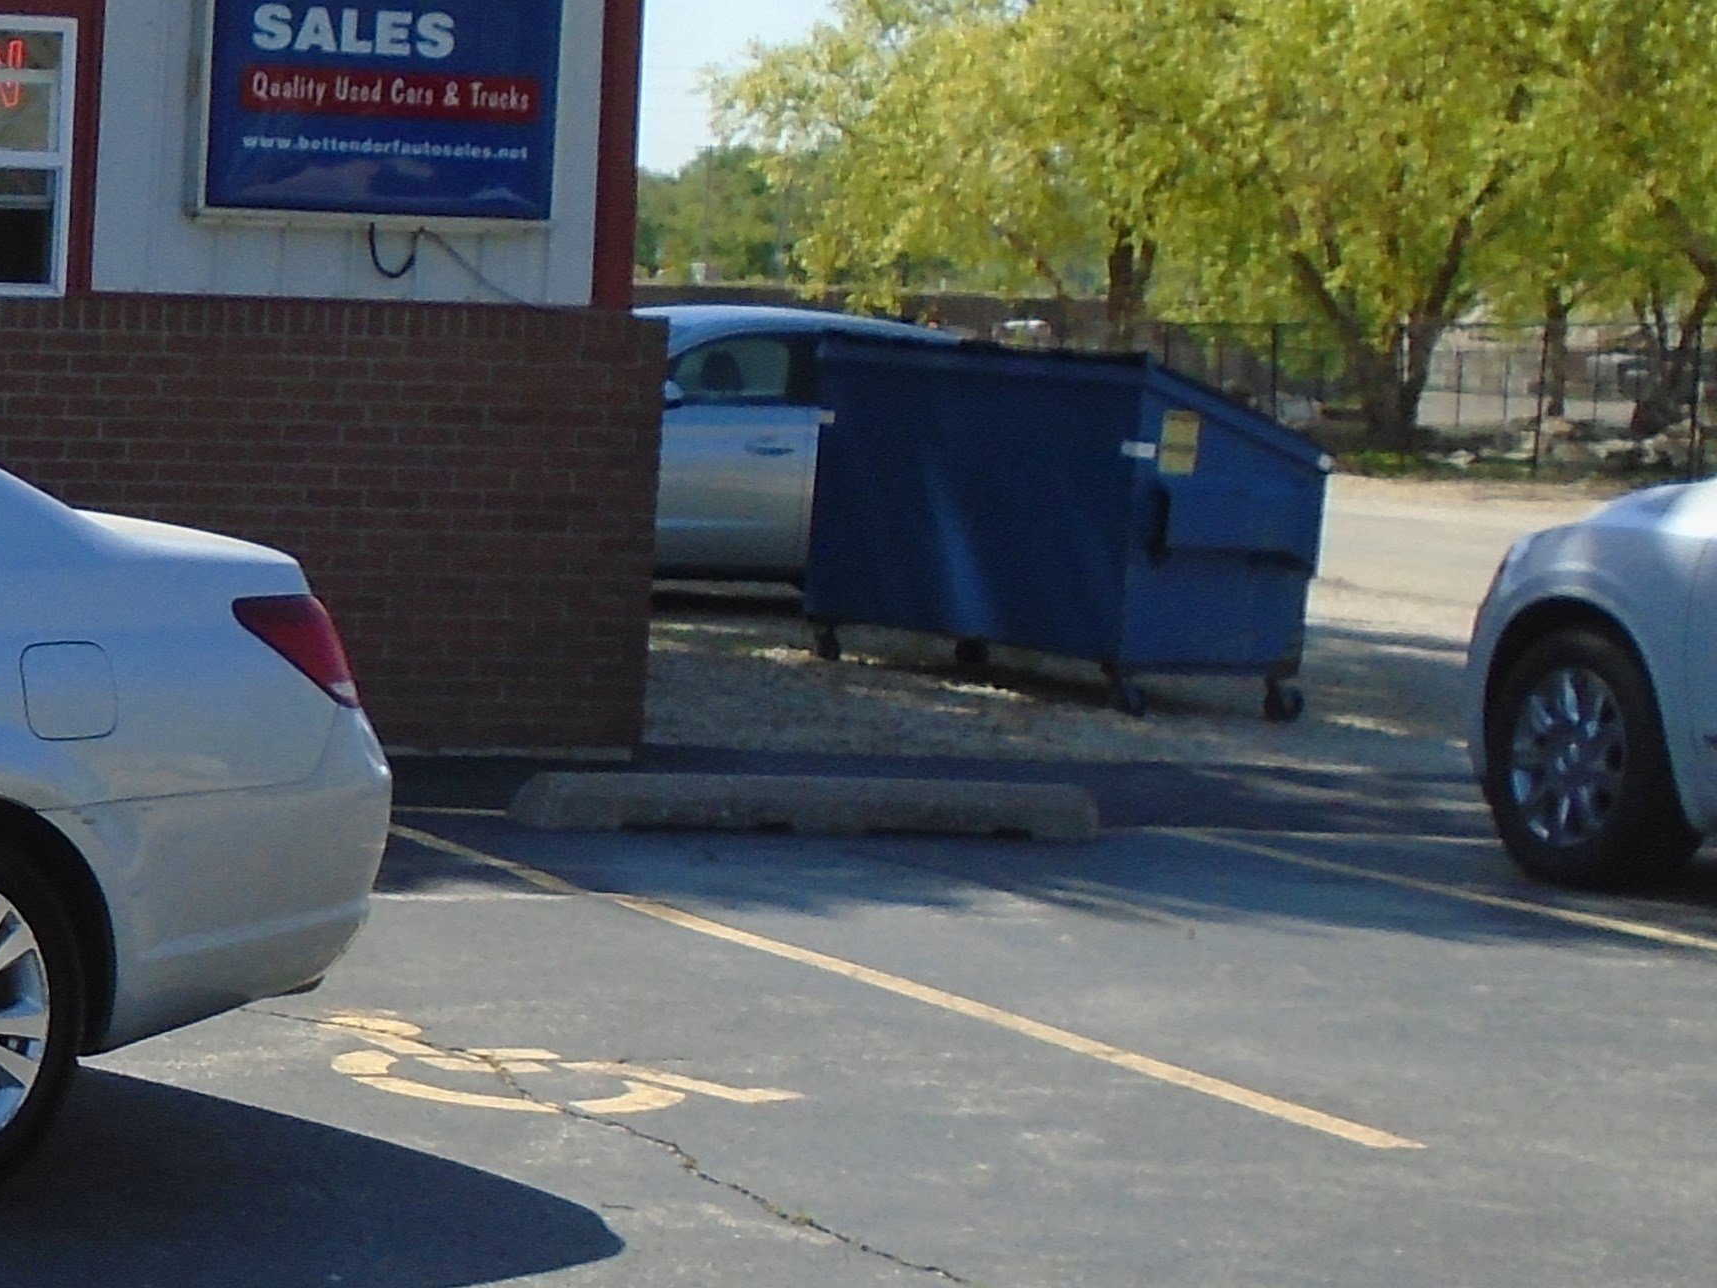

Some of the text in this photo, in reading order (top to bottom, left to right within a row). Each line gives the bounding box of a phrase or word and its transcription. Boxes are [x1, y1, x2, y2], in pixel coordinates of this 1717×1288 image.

[251, 3, 456, 60] SALES
[252, 71, 529, 110] Quality Used Cars & Trucks
